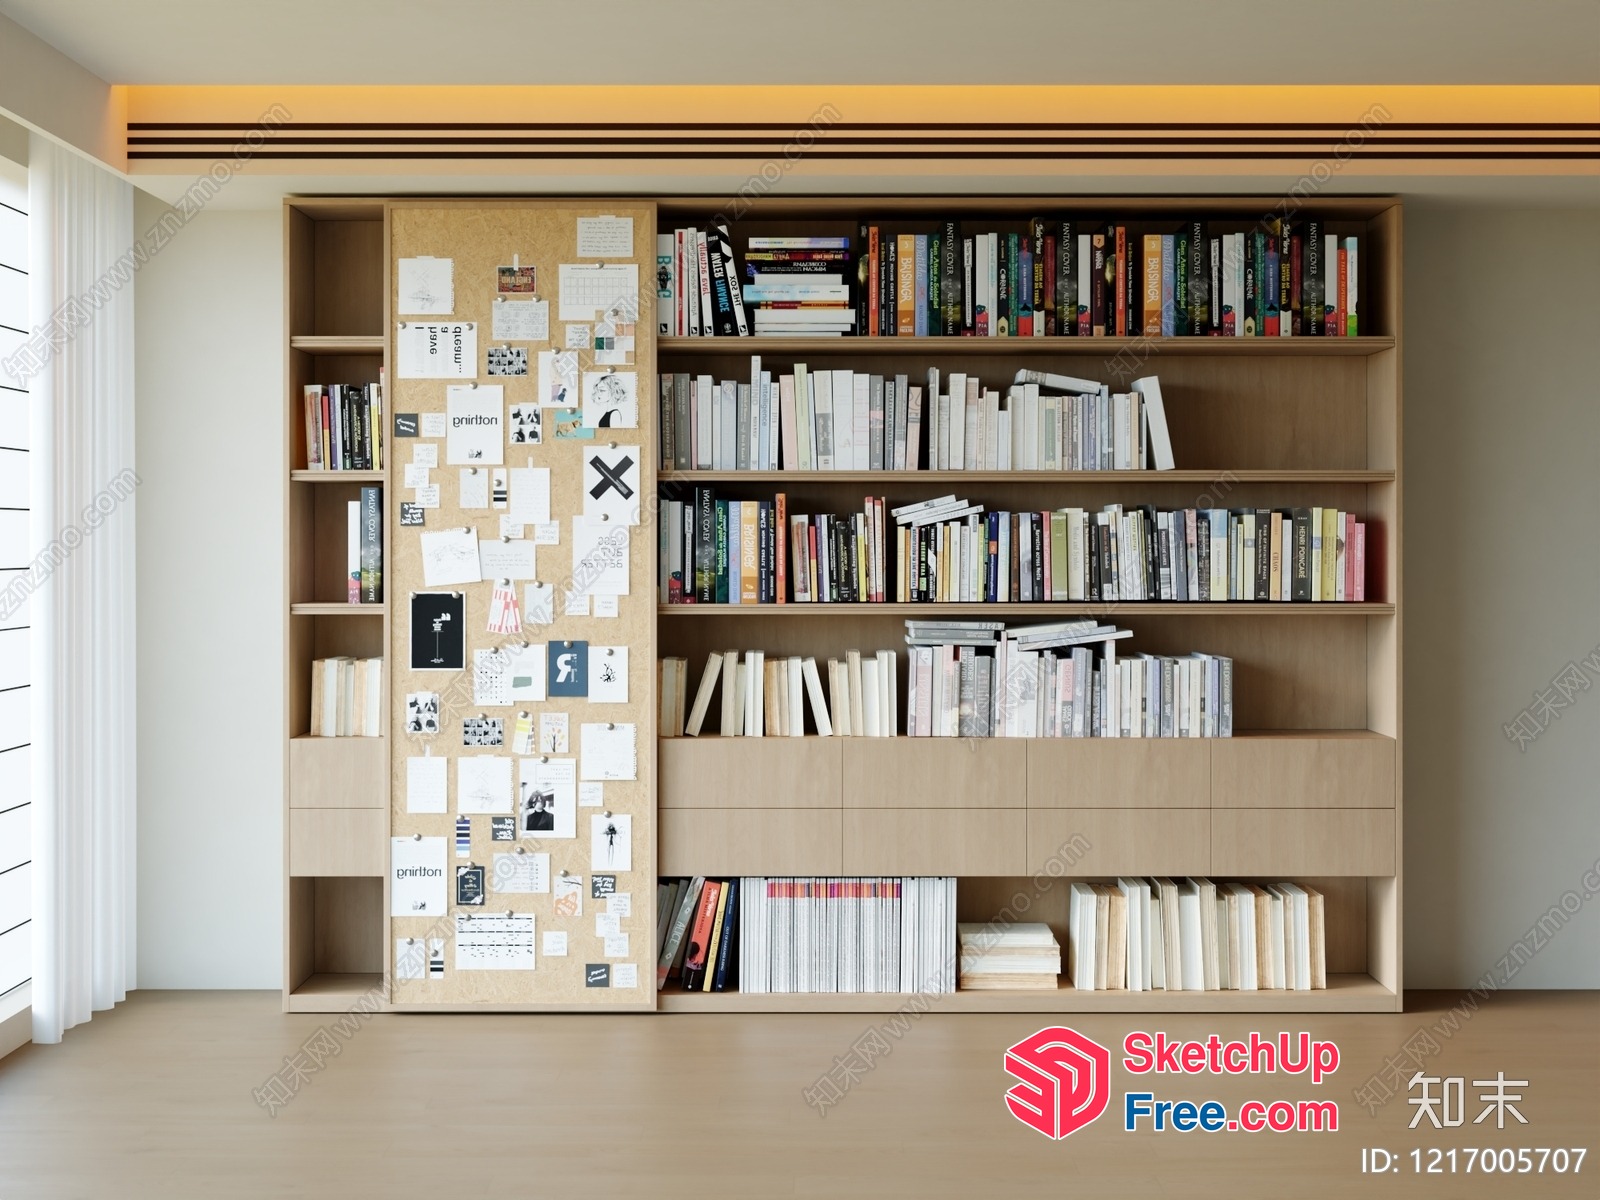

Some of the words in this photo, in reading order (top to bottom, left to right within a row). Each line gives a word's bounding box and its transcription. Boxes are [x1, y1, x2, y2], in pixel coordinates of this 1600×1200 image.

[900, 258, 912, 303] BRISINGR
[1147, 257, 1159, 303] BRISINGR
[760, 384, 769, 426] intelligence
[670, 921, 686, 945] ALICE
